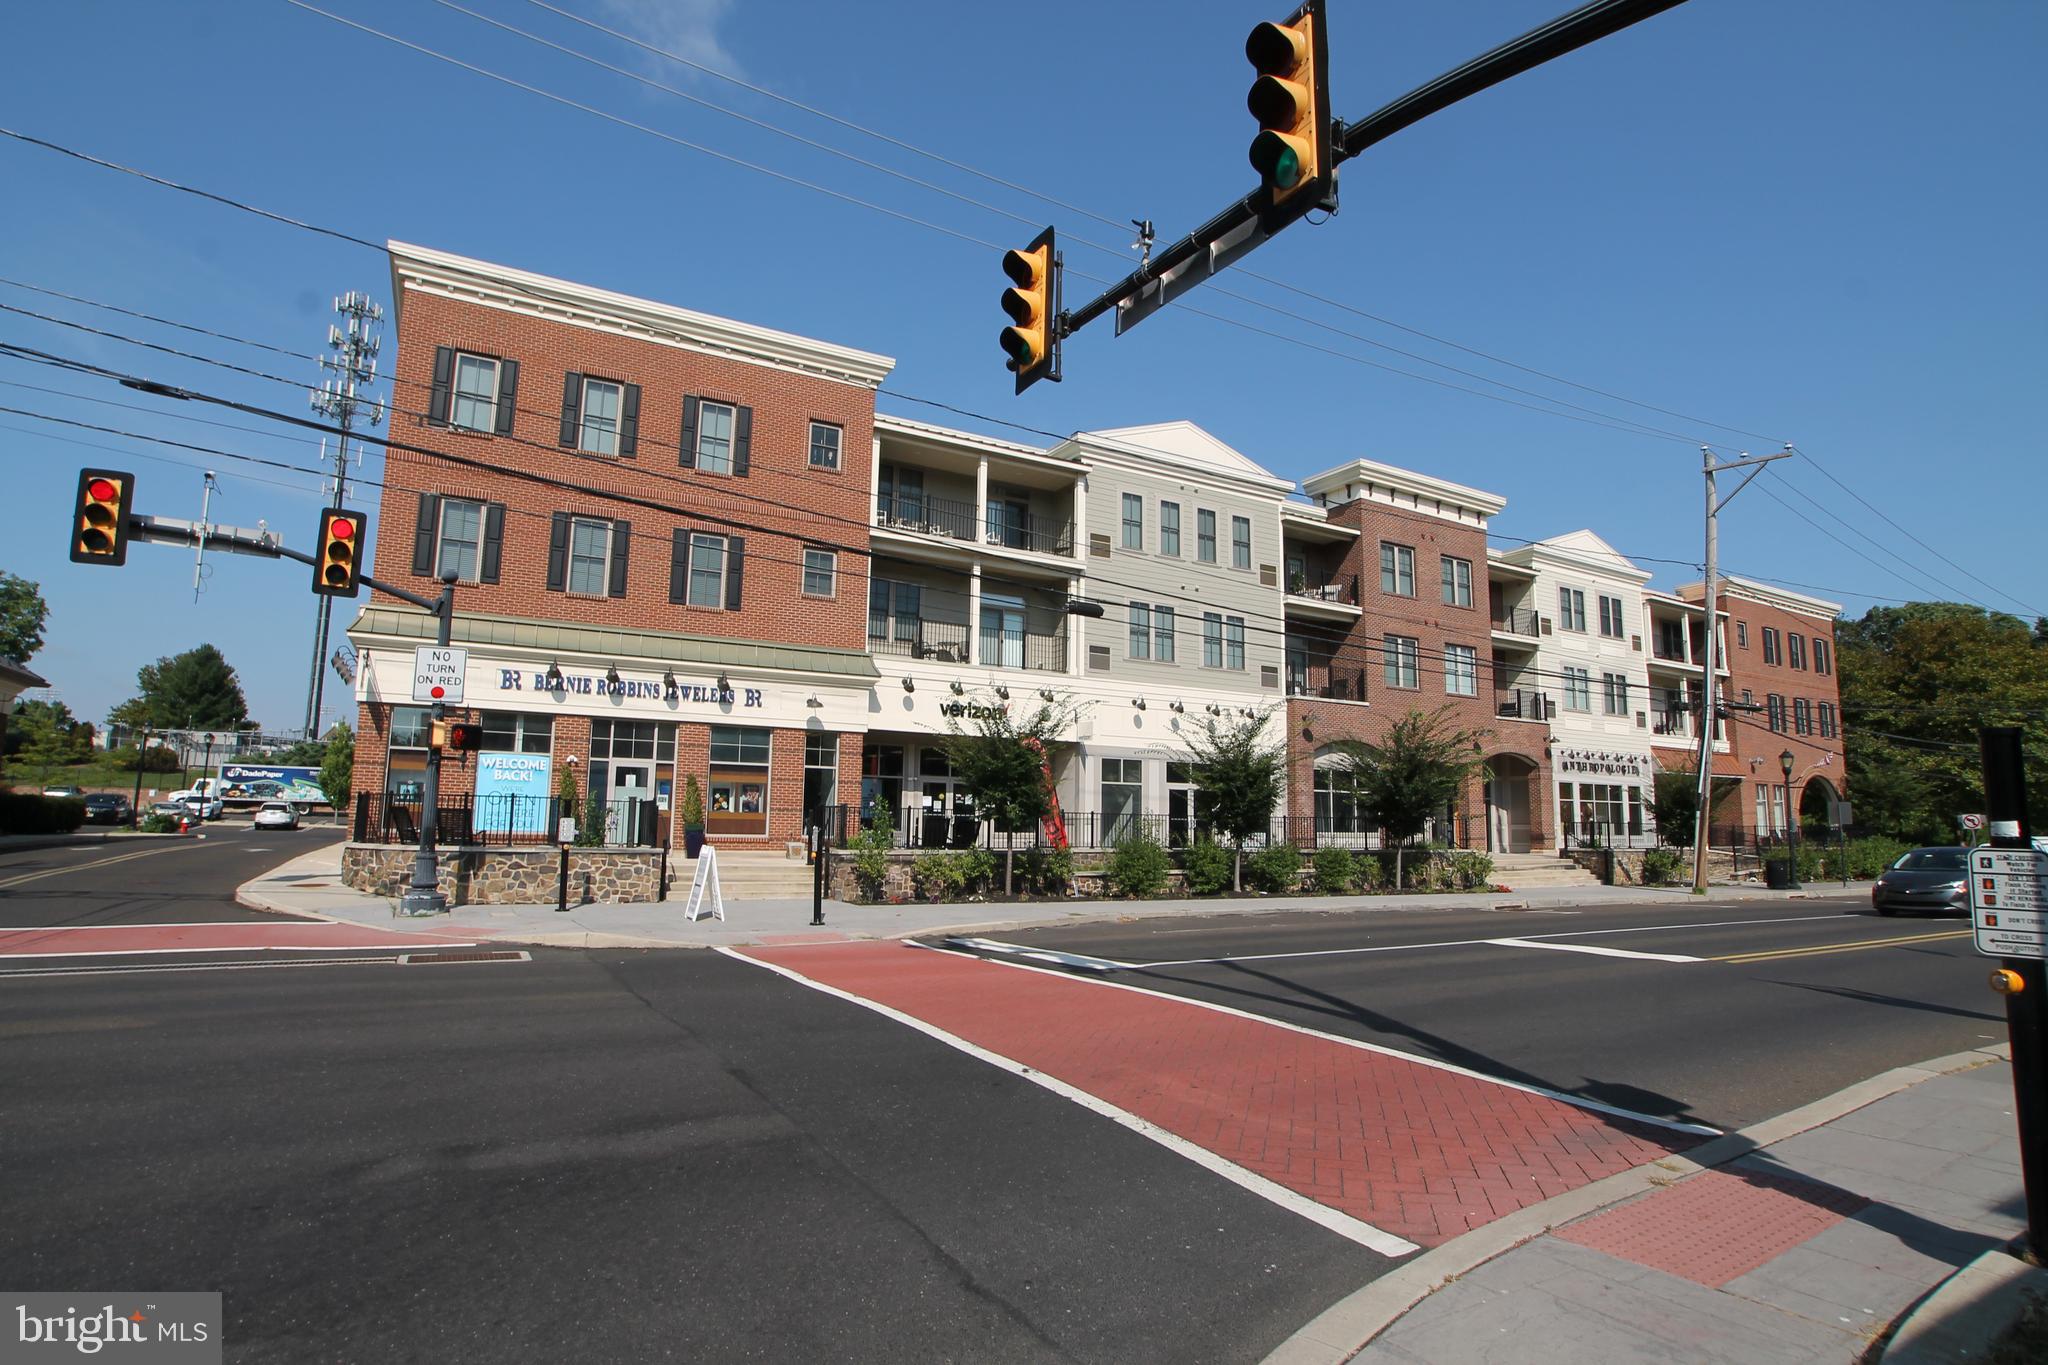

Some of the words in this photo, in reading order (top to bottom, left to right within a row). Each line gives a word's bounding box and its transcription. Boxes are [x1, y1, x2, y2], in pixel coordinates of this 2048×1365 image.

[432, 651, 451, 662] NO
[427, 663, 456, 674] TURN
[417, 675, 434, 684] ON
[439, 676, 462, 686] RED
[500, 669, 522, 690] BR
[534, 674, 592, 695] BERNIE
[596, 678, 660, 700] ROBBINS
[663, 684, 735, 705] JEWELERS
[744, 688, 763, 708] BR
[940, 701, 1003, 720] verizon
[482, 757, 547, 771] WELCOME
[242, 770, 284, 778] DadePaper
[494, 769, 533, 782] BACK!
